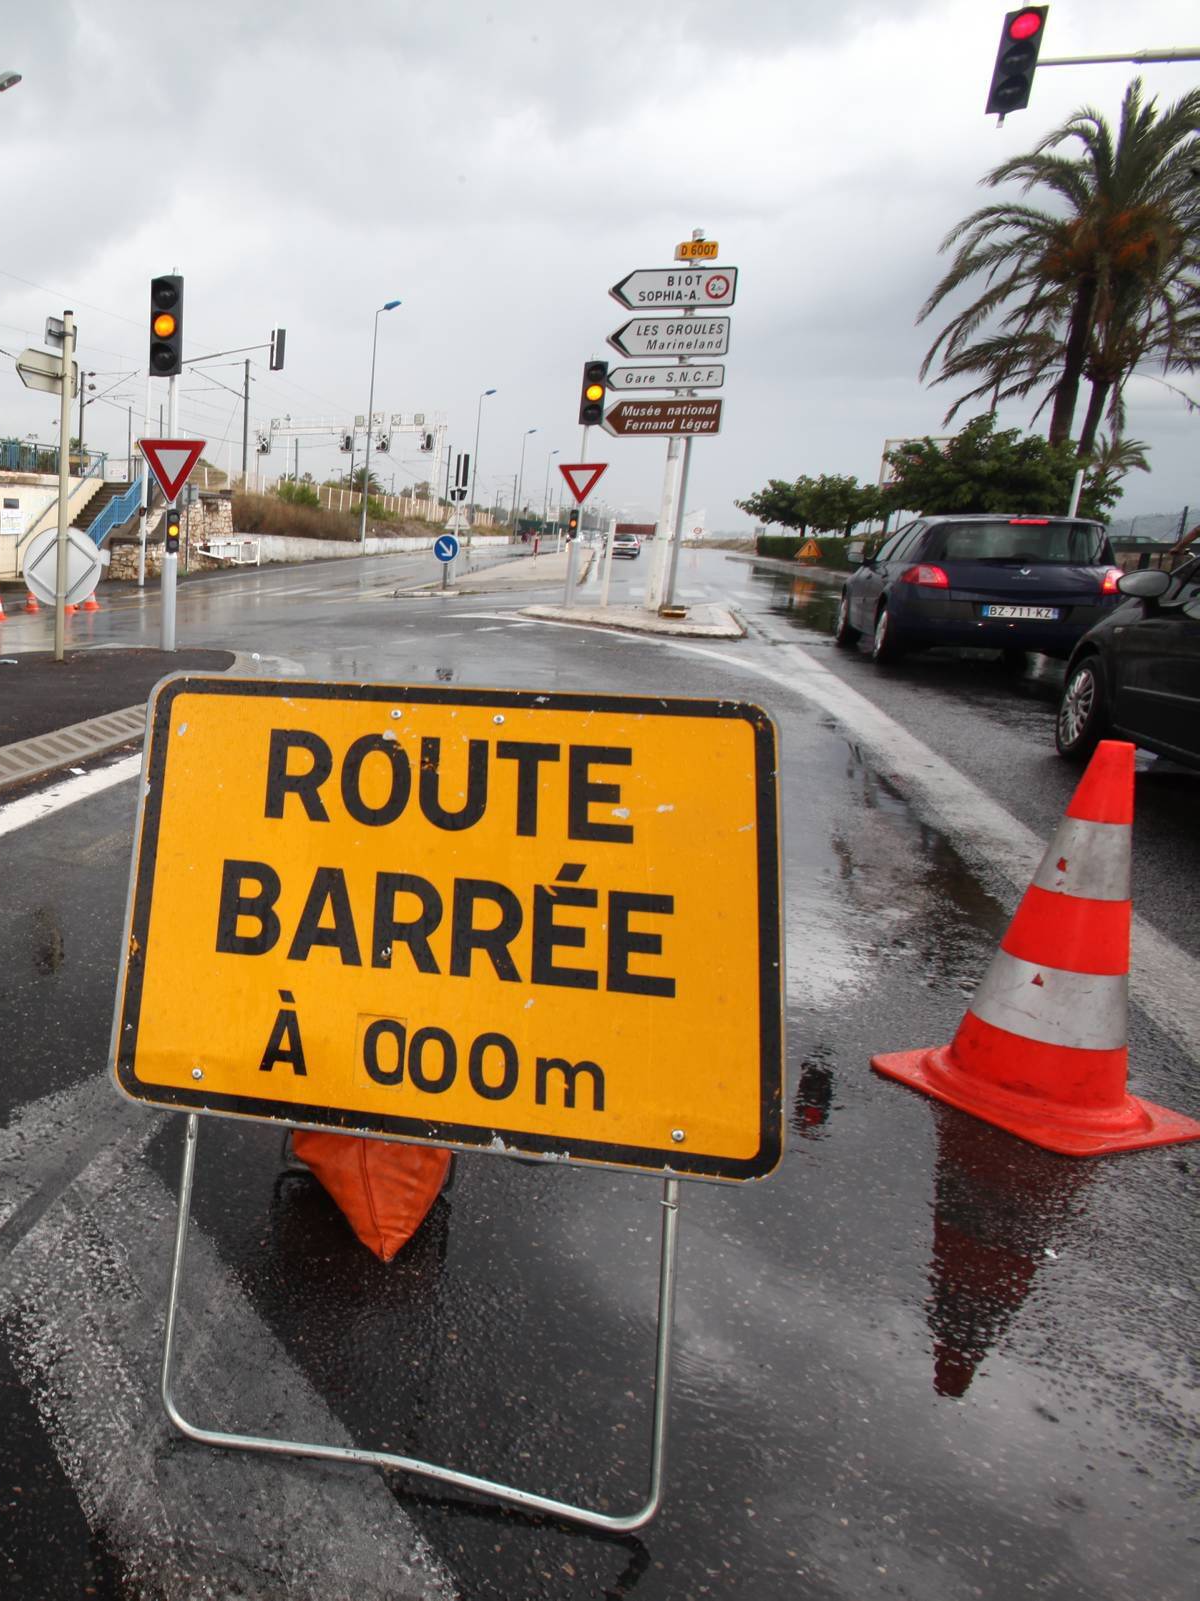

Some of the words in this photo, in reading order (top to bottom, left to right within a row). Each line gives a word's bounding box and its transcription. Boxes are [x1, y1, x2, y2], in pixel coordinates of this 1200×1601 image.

[681, 245, 688, 256] D
[690, 244, 716, 255] 6007
[666, 275, 703, 287] BIOT
[638, 290, 701, 302] SOPHIA-A.
[636, 324, 659, 336] LES
[666, 323, 724, 336] GROULES
[646, 339, 723, 351] Marineland
[625, 373, 656, 384] Gare
[666, 370, 719, 383] S.N.C.F.
[621, 405, 662, 417] Musée
[666, 404, 718, 416] national
[624, 418, 675, 431] Fernand
[680, 417, 716, 431] Léger
[264, 728, 633, 844] ROUTE
[214, 858, 676, 998] BARRÉE
[258, 989, 307, 1076] À
